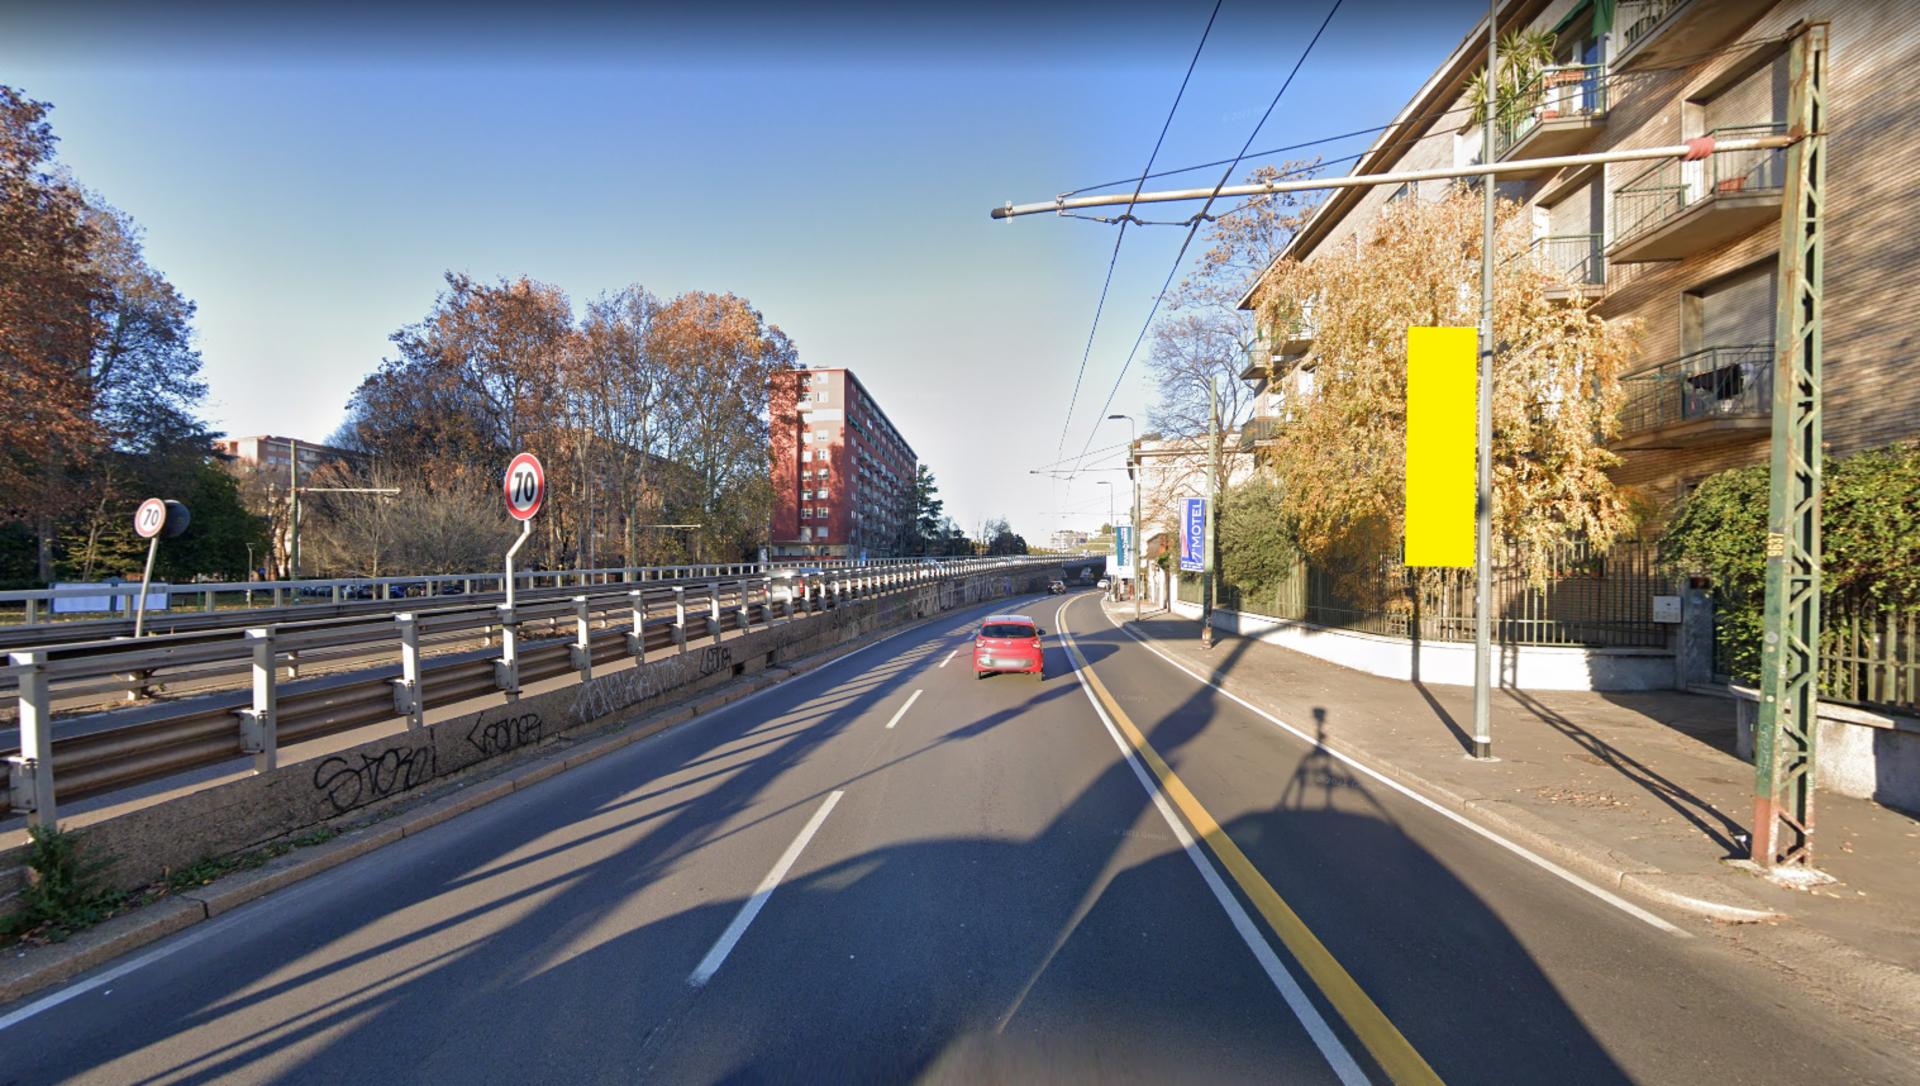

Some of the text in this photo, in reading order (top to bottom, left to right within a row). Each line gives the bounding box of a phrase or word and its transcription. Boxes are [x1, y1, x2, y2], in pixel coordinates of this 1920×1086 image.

[514, 471, 535, 503] 70
[143, 508, 160, 526] 70
[1191, 499, 1202, 548] MOTEL
[1767, 532, 1785, 557] 9637
